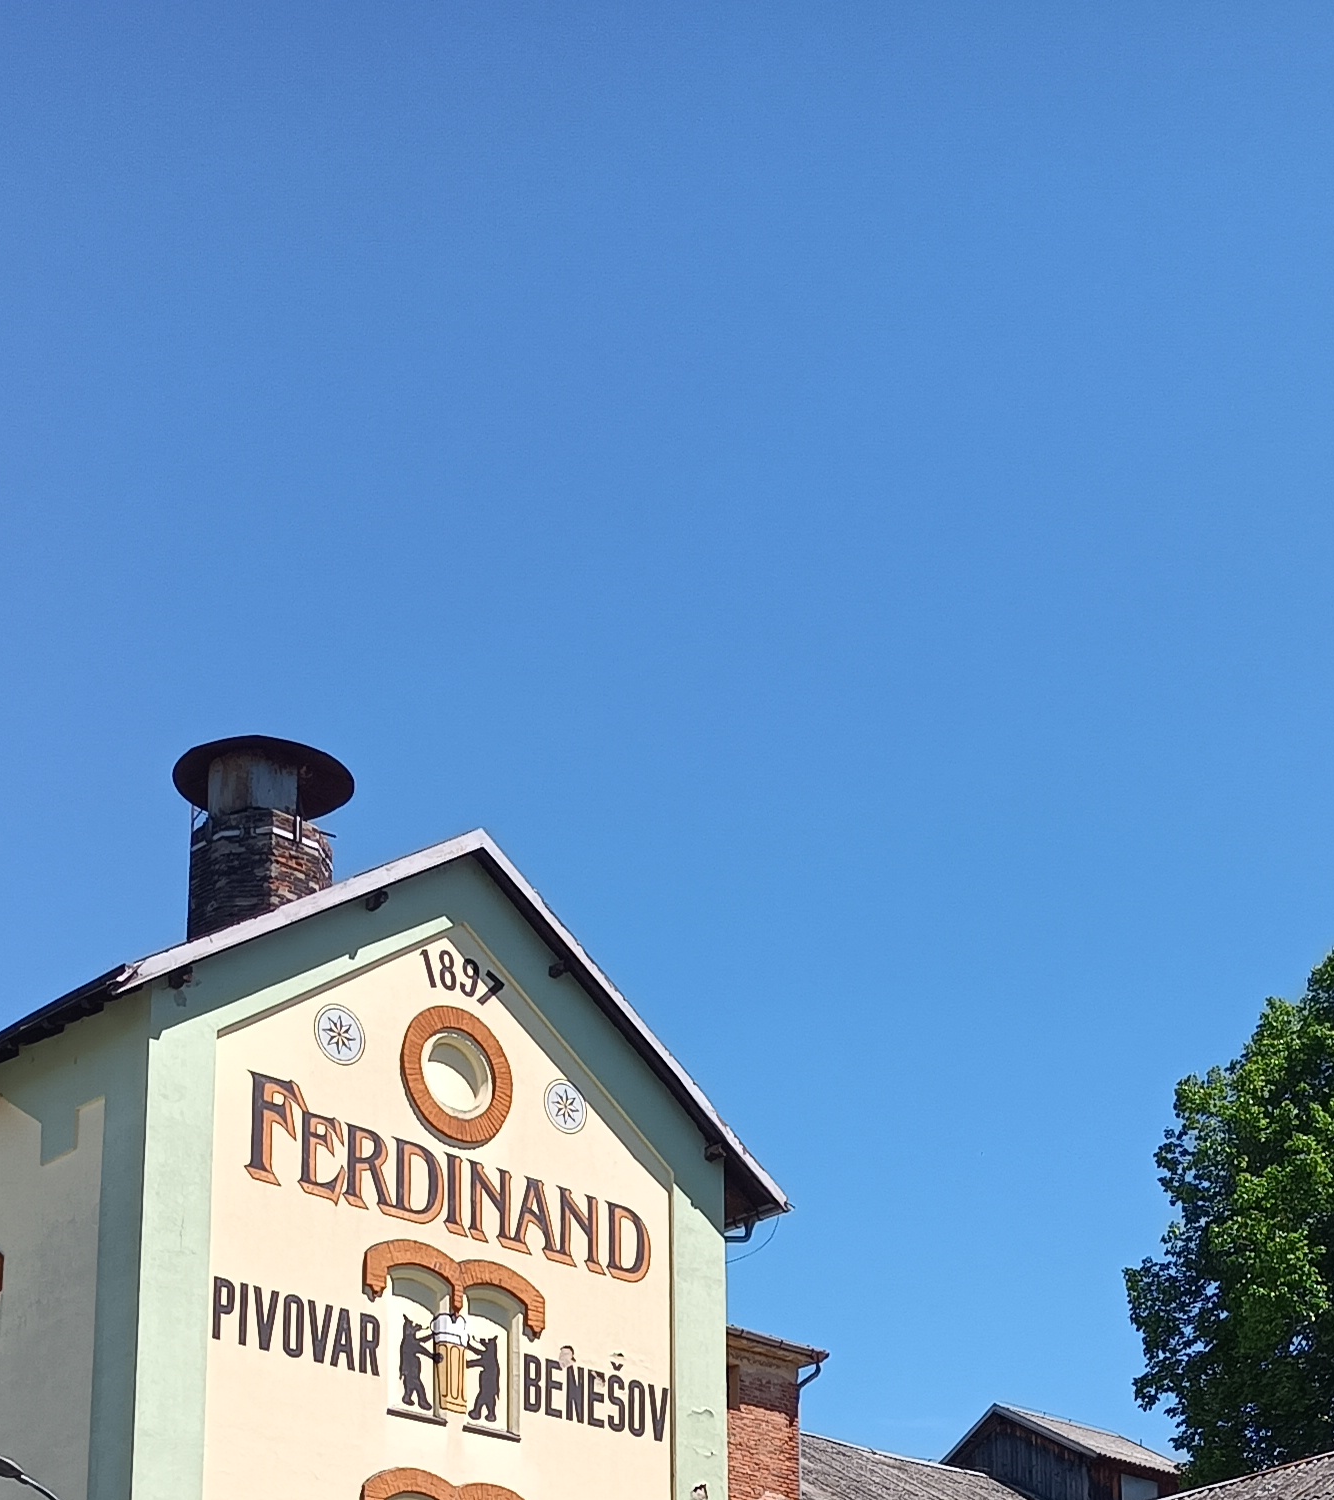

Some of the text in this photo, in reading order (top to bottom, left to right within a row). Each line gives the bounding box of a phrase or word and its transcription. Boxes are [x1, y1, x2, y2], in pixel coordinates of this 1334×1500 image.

[419, 947, 505, 1007] 1897
[243, 1069, 651, 1284] FERDINAND
[211, 1275, 670, 1442] PIVOVAR BENEŠOV
